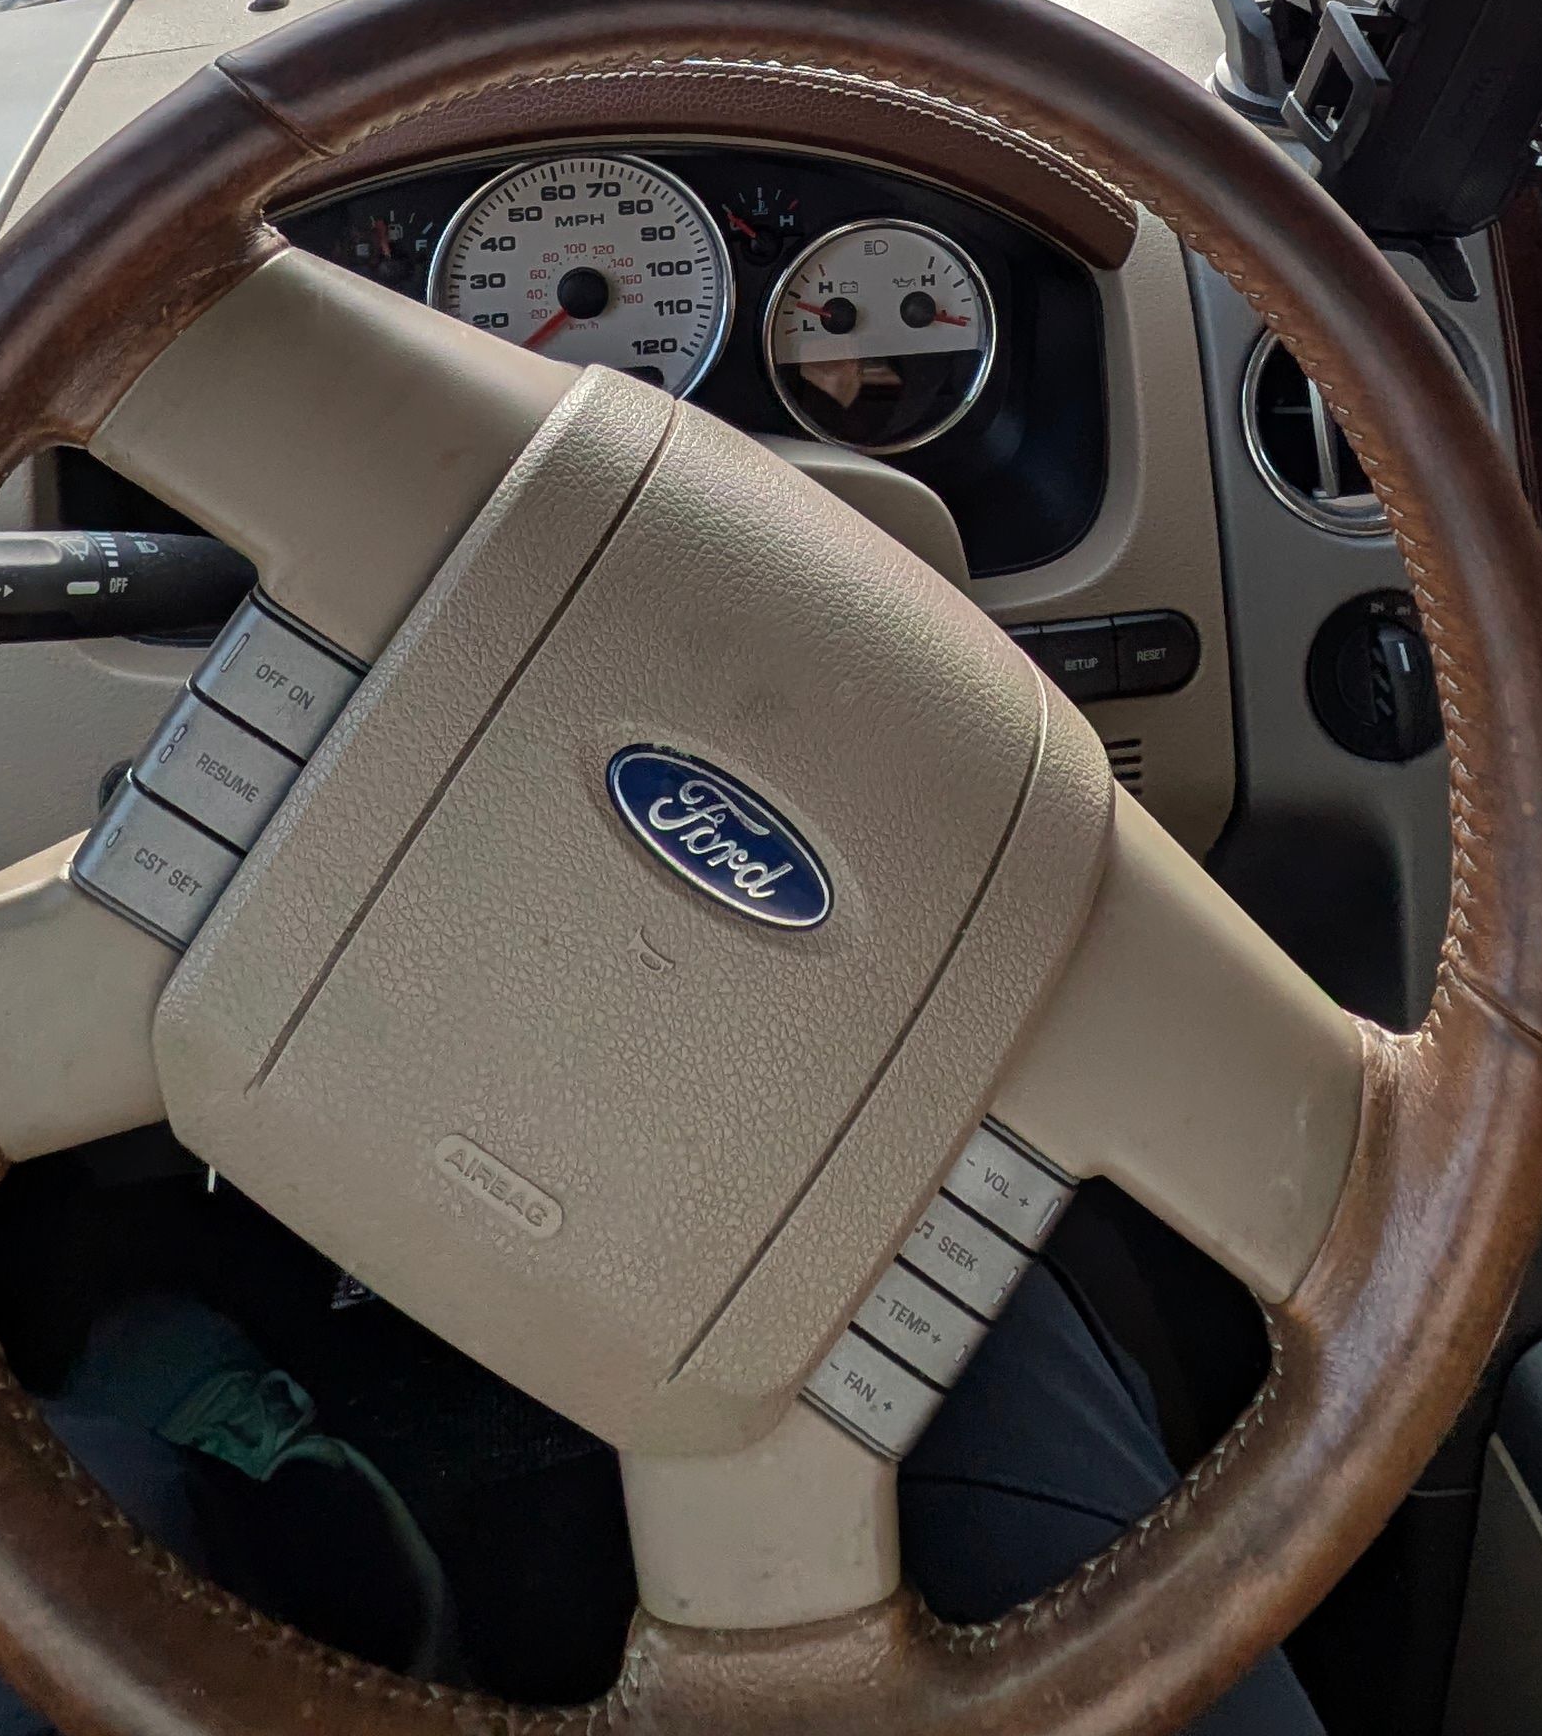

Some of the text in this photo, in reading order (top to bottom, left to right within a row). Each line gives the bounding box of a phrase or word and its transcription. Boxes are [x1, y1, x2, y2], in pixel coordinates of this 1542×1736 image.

[540, 184, 576, 202] 60
[586, 181, 621, 199] 70
[507, 206, 543, 223] 50
[618, 199, 654, 216] 80
[555, 213, 606, 228] MPH
[779, 215, 795, 227] H
[641, 226, 676, 242] 90
[415, 239, 428, 252] F
[480, 236, 517, 252] 40
[564, 243, 587, 254] 100
[592, 245, 615, 256] 120
[542, 252, 560, 263] 80
[611, 257, 634, 268] 140
[530, 269, 548, 280] 60
[646, 260, 693, 277] 100
[470, 273, 506, 289] 30
[620, 274, 643, 285] 160
[920, 274, 936, 287] H
[526, 289, 544, 300] 40
[818, 282, 834, 294] H
[621, 293, 644, 305] 180
[654, 300, 693, 316] 110
[473, 313, 509, 329] 20
[802, 320, 816, 332] L
[632, 337, 678, 355] 120
[109, 577, 129, 594] OFF
[1136, 647, 1167, 663] RESET
[256, 663, 316, 711] OFF ON
[195, 751, 260, 804] RESUME
[648, 779, 794, 898] Ford
[133, 847, 203, 898] CST SET
[444, 1149, 548, 1227] AIRBAG
[983, 1167, 1011, 1199] VOL
[938, 1235, 979, 1272] SEEK
[888, 1300, 931, 1336] TEMP
[843, 1371, 877, 1402] FAN
